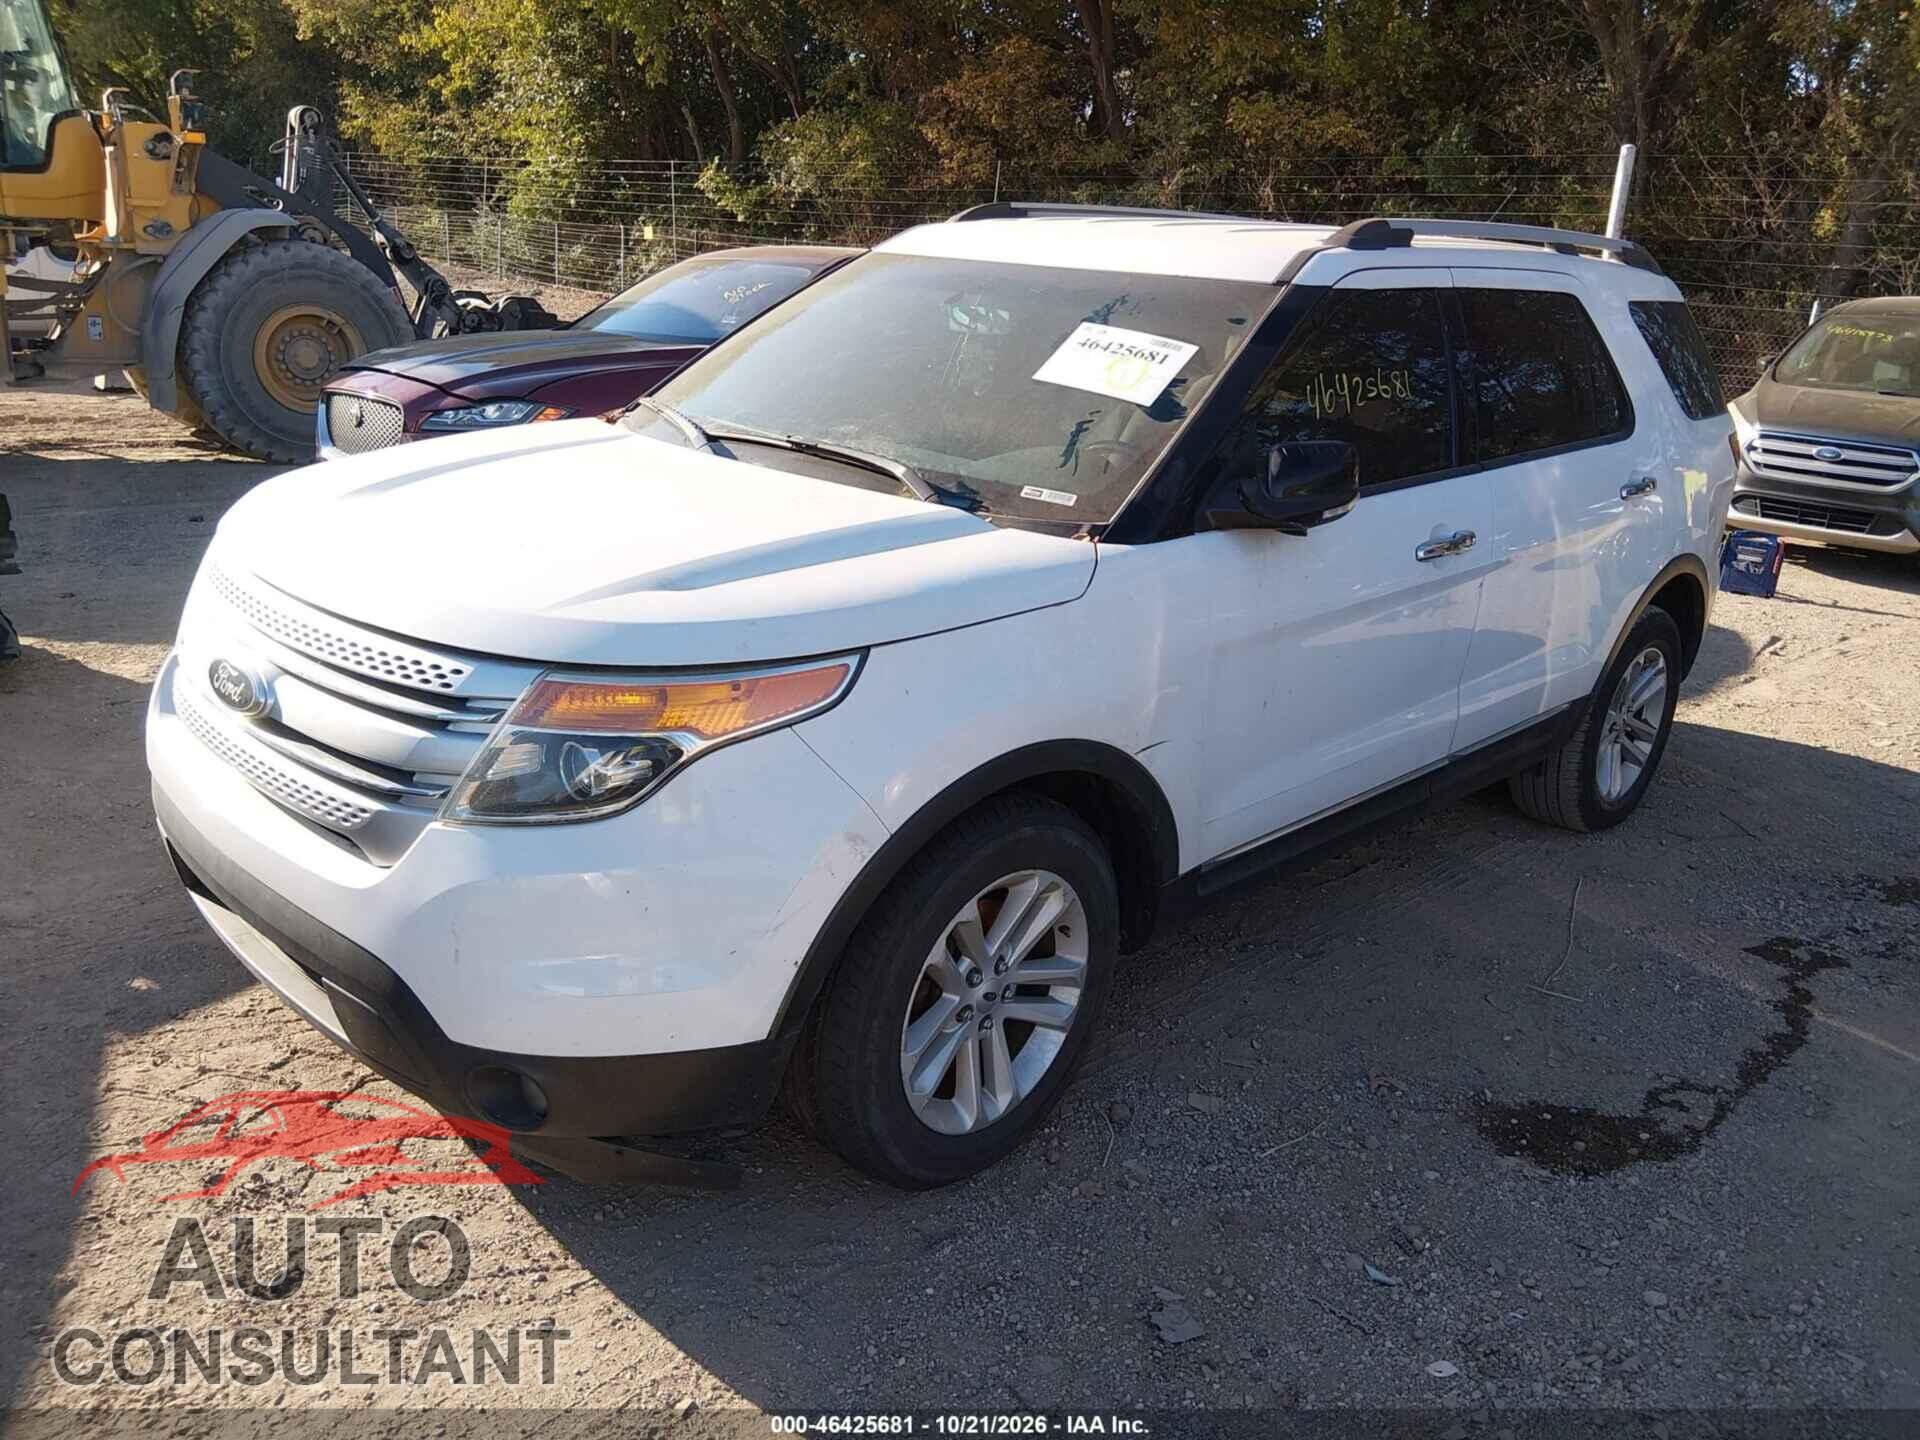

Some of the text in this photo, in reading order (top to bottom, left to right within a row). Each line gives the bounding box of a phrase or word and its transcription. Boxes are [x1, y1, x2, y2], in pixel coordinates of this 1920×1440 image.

[1077, 337, 1169, 365] 46425681
[1306, 367, 1412, 420] 46425681
[212, 661, 246, 703] Ford
